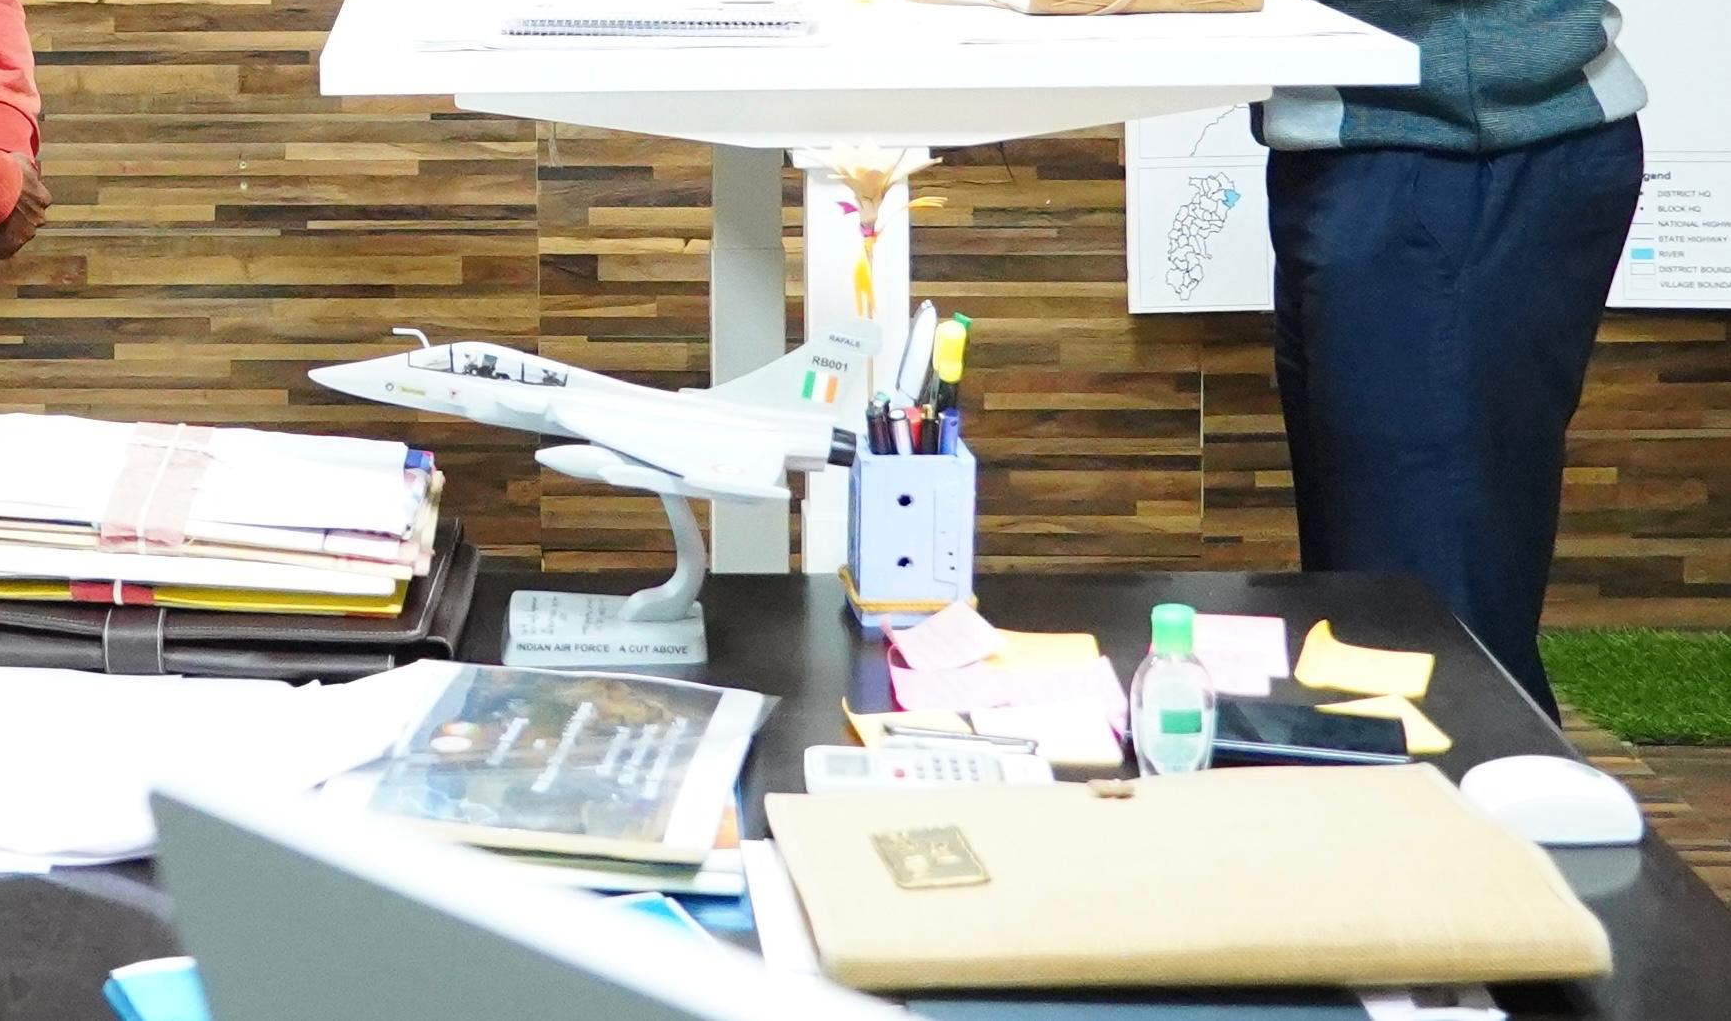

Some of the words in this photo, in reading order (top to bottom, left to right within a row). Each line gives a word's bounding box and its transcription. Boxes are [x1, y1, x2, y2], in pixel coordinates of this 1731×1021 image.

[1642, 171, 1671, 182] gend
[1657, 190, 1695, 198] DISTRICT
[1698, 190, 1711, 198] HQ
[1657, 205, 1685, 213] BLOCK
[1688, 205, 1701, 213] HQ
[1658, 235, 1685, 243] STATE
[1658, 250, 1684, 258] RIVER
[1660, 281, 1694, 289] VILLAGE
[829, 334, 861, 348] RAFALE
[812, 355, 848, 371] RB001
[516, 643, 551, 652] INDIAN
[554, 643, 571, 652] AIR
[574, 643, 610, 652] FORCE
[619, 644, 626, 653] A
[629, 644, 649, 653] CUT
[652, 645, 688, 654] ABOVE
